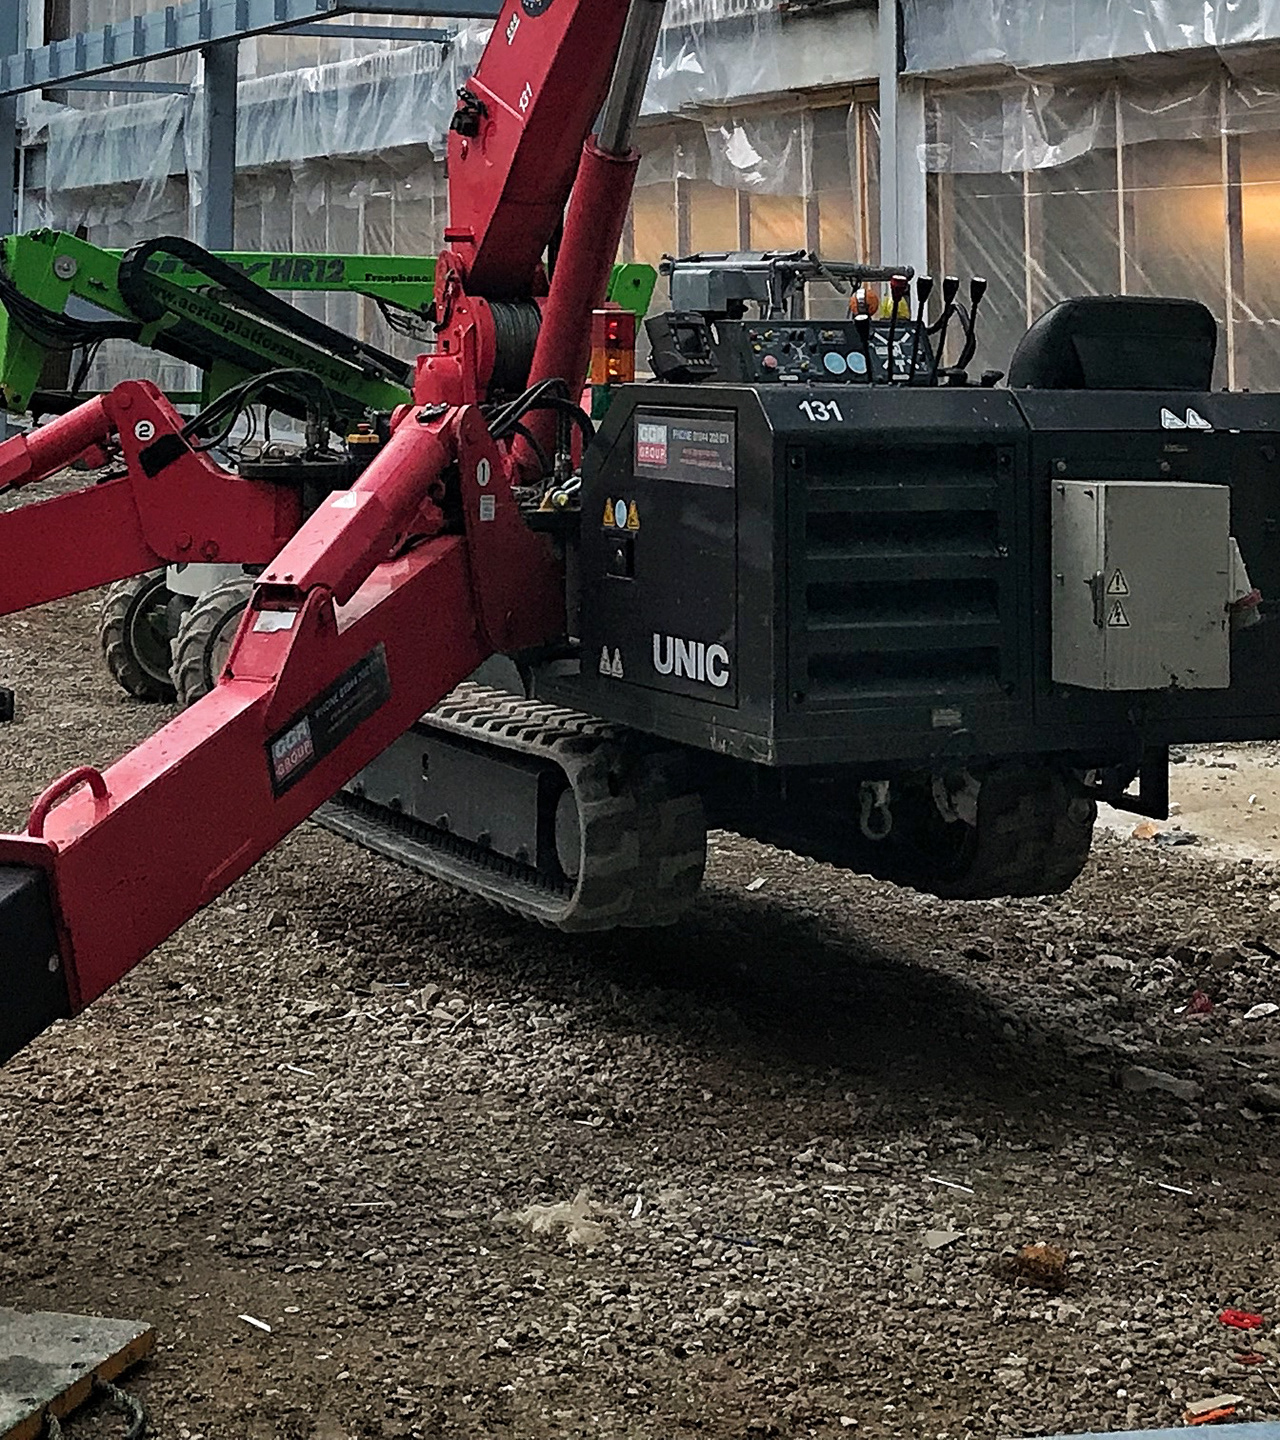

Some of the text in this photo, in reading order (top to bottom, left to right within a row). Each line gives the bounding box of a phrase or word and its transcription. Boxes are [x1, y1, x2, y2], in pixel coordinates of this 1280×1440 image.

[269, 259, 345, 283] HR12
[798, 400, 844, 422] 131
[139, 424, 151, 436] 2
[653, 633, 729, 687] UNIC
